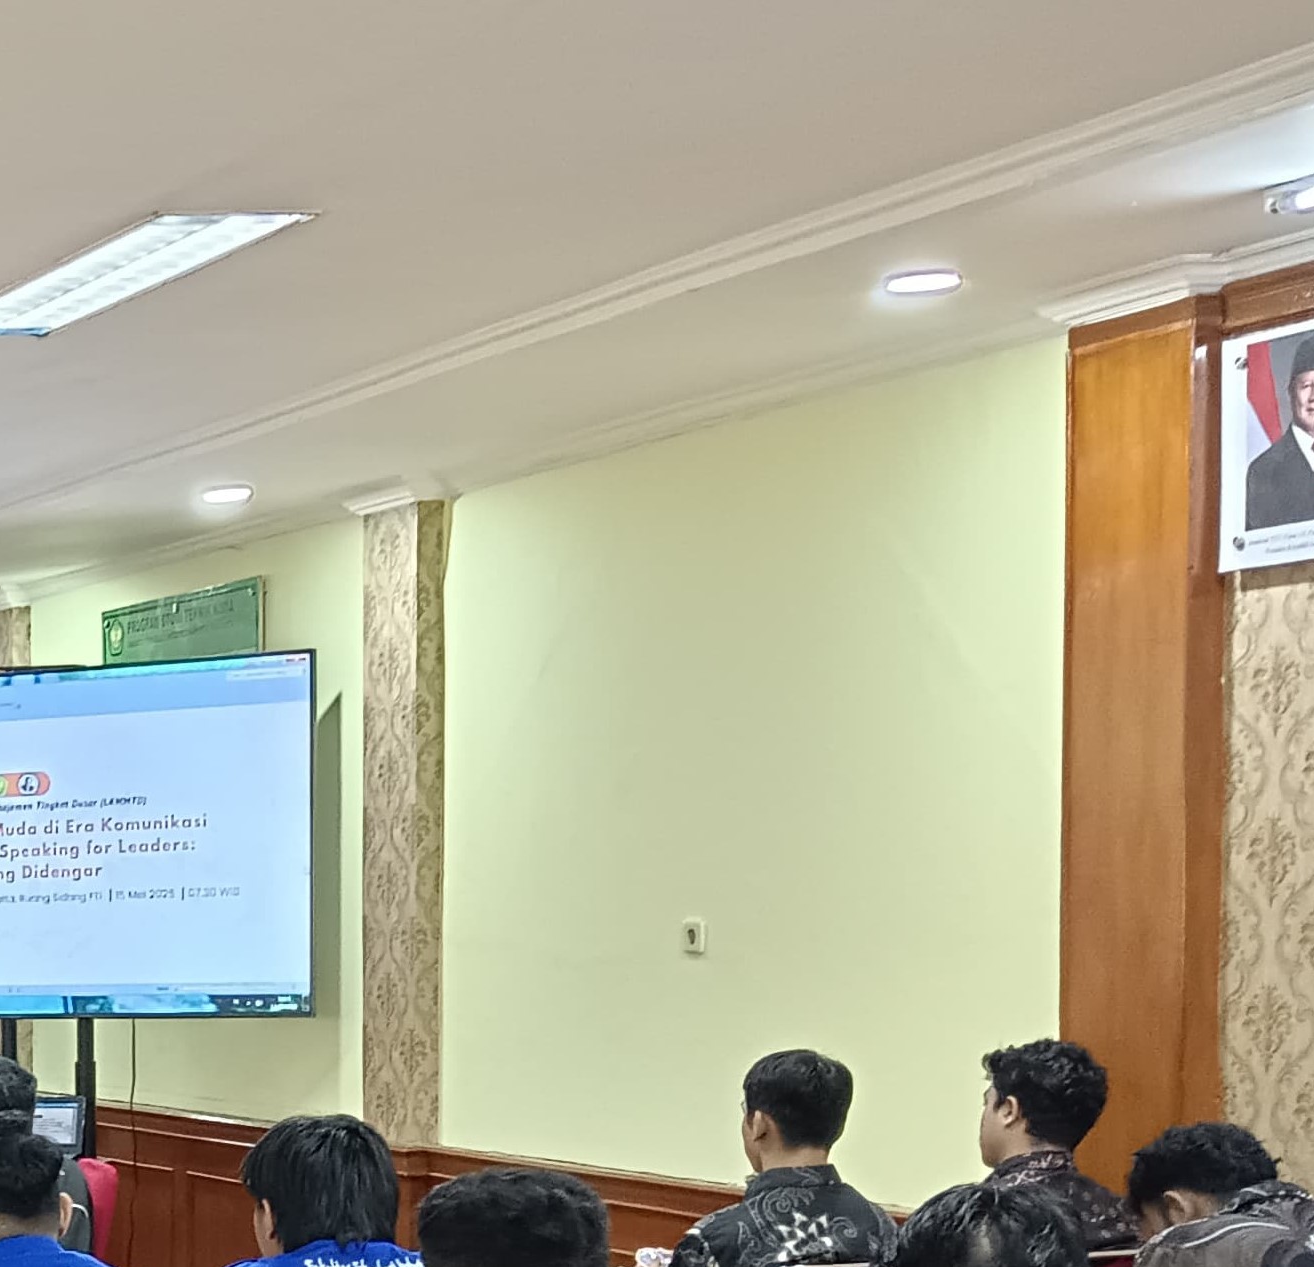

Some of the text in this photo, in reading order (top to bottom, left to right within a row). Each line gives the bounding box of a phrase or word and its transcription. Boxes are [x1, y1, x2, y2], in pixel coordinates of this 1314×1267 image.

[43, 819, 59, 835] di
[66, 819, 94, 834] Era
[101, 813, 208, 832] Komunikasi
[0, 842, 79, 861] Speaking
[86, 839, 112, 855] for
[118, 838, 196, 853] Leaders:
[22, 864, 103, 882] Didengar
